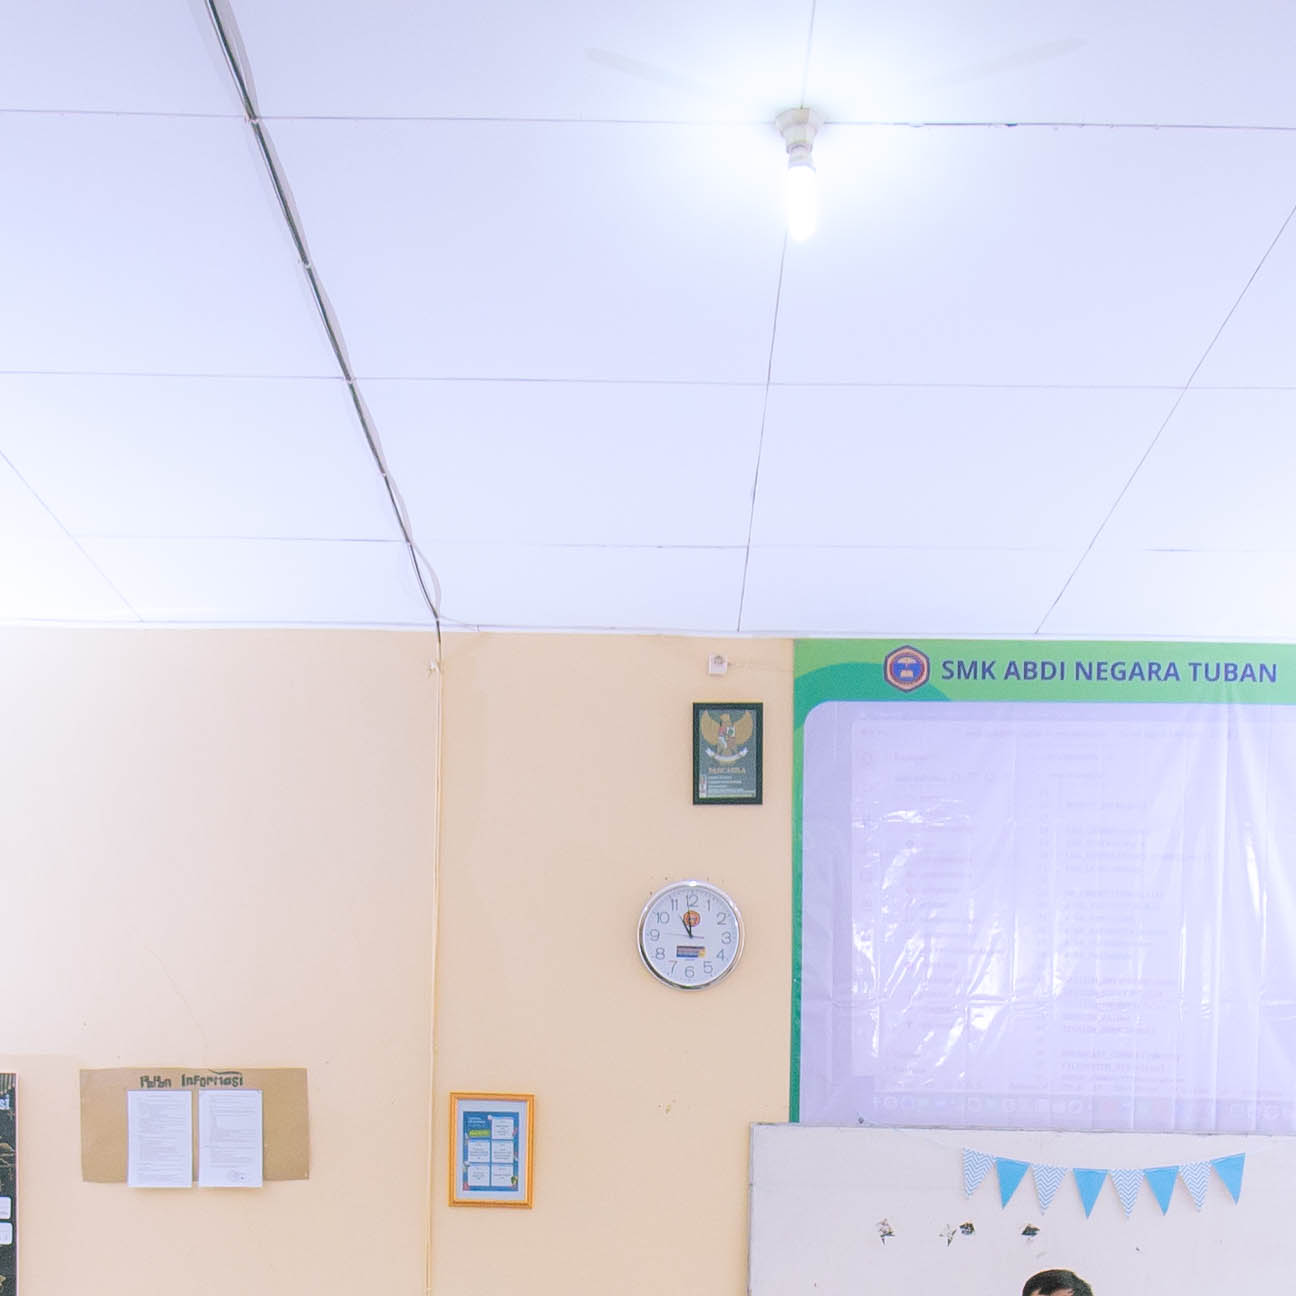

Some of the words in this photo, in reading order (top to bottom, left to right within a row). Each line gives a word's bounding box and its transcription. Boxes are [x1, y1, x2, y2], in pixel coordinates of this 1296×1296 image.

[941, 658, 996, 684] SMK
[1003, 659, 1066, 684] ABDI
[1074, 660, 1181, 685] NEGARA
[1189, 661, 1278, 685] TUBAN
[671, 898, 679, 912] 11
[656, 911, 671, 925] 10
[716, 911, 727, 926] 2
[649, 928, 660, 942] 9
[721, 931, 732, 945] 3
[655, 946, 666, 960] 8
[716, 948, 725, 961] 4
[669, 960, 678, 977] 7
[684, 965, 695, 978] 6
[703, 960, 714, 975] 5
